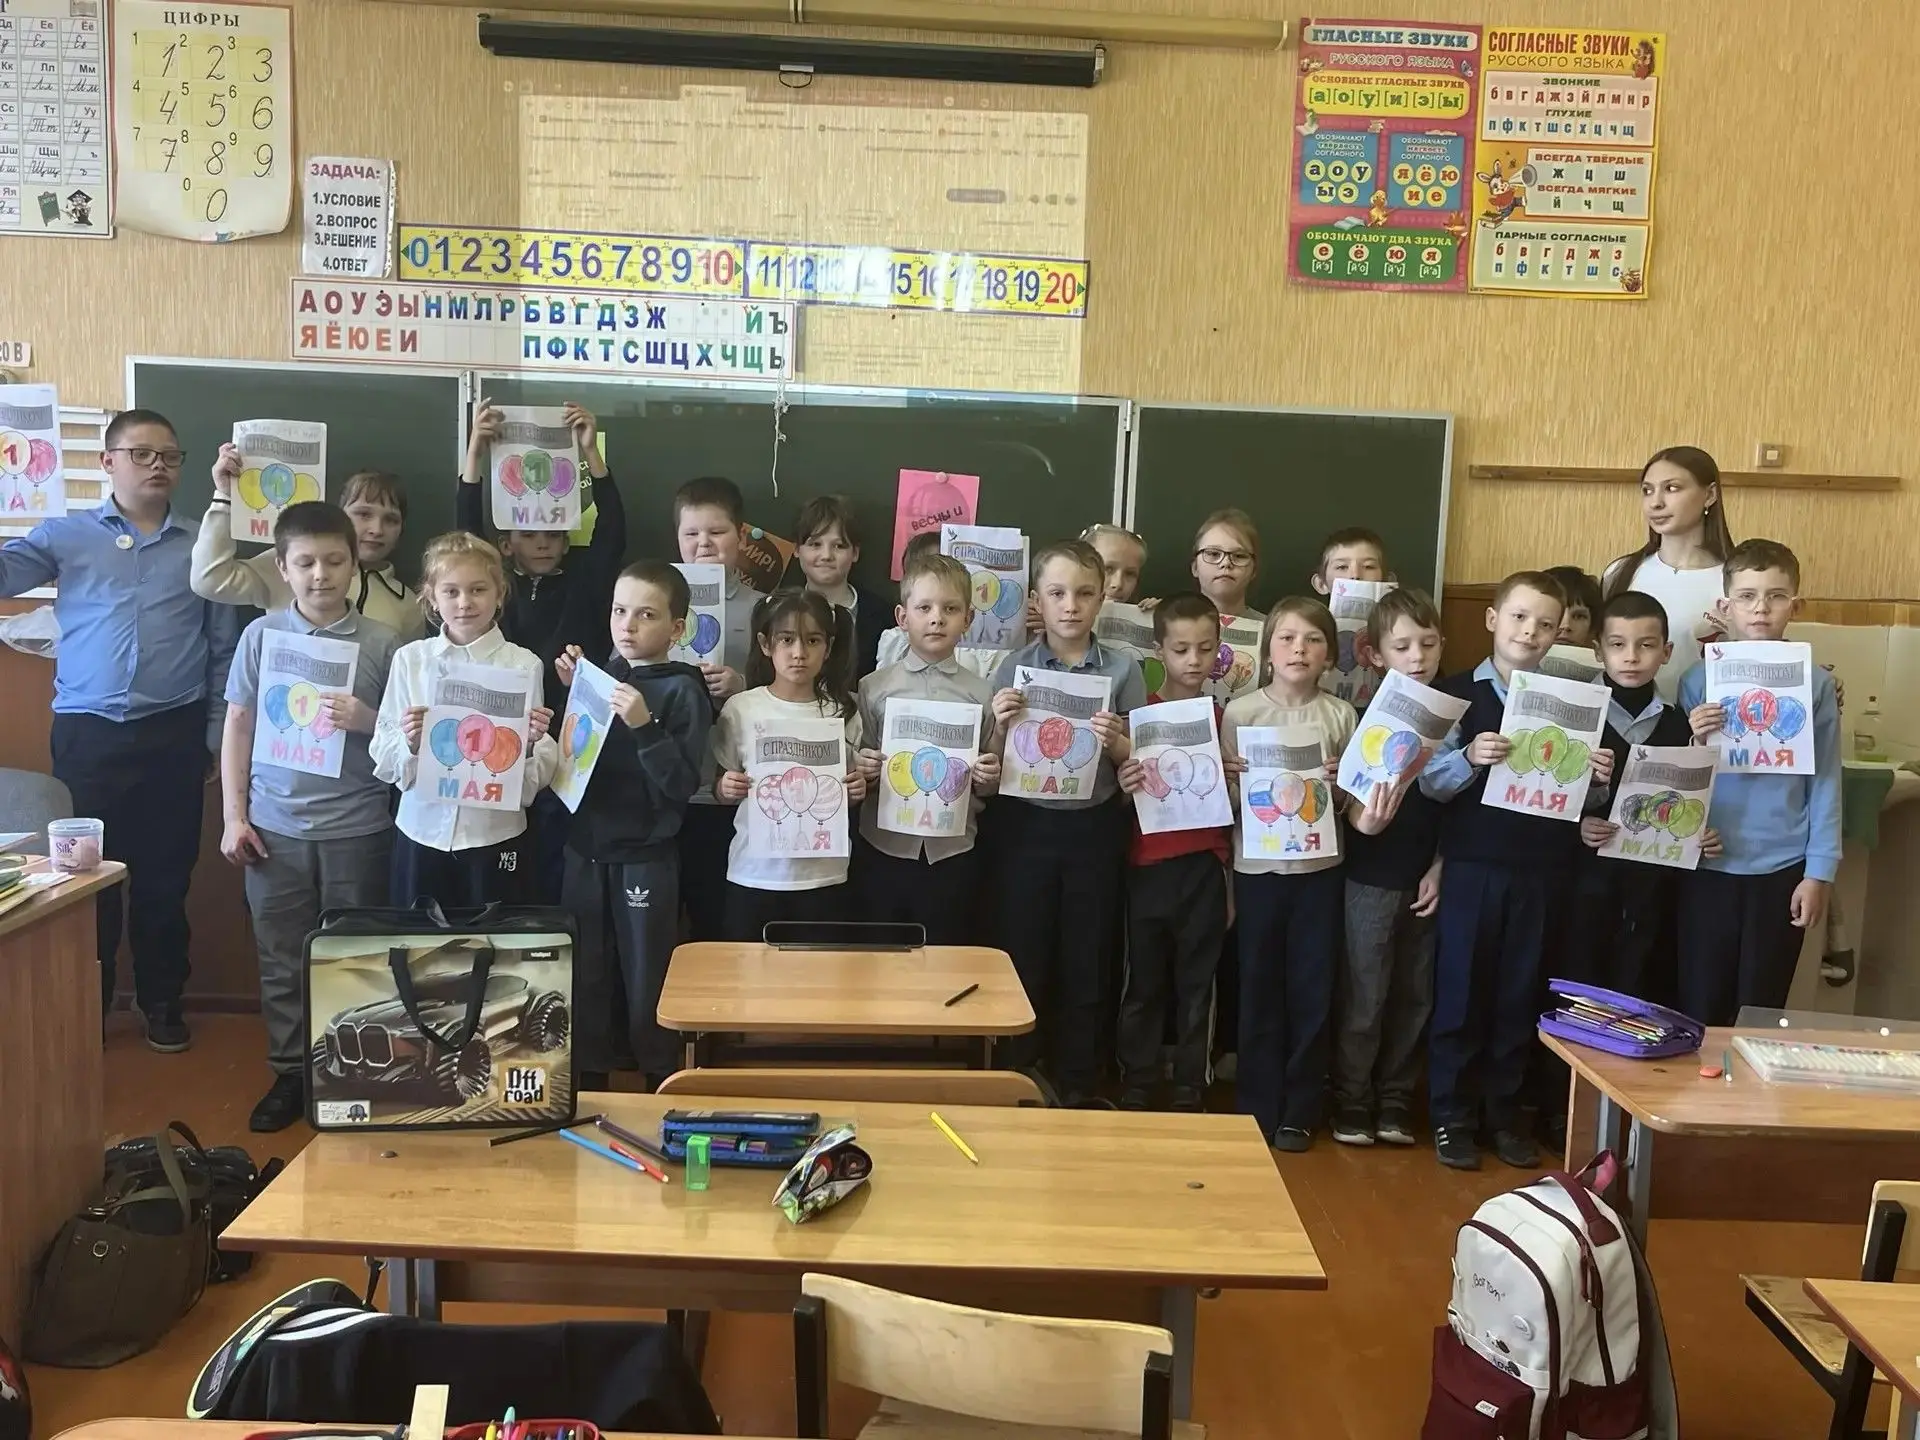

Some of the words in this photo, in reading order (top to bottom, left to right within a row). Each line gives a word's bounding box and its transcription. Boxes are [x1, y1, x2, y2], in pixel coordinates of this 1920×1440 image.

[163, 10, 241, 28] ЦИФРЫ
[1312, 29, 1403, 44] ГЛАСНЫЕ
[1408, 32, 1468, 48] ЗВУКИ
[1488, 31, 1578, 54] СОГЛАСНЫЕ
[1583, 36, 1630, 56] ЗВУКИ
[161, 43, 177, 77] 1
[206, 45, 225, 80] 2
[253, 48, 273, 82] 3
[1329, 52, 1404, 66] РУССКОГО
[1407, 55, 1455, 69] ЯЗЫКА
[1487, 54, 1568, 68] РУССКОГО
[1573, 57, 1625, 69] ЯЗЫКА
[1312, 75, 1373, 85] ОСНОВНЫЕ
[1375, 77, 1426, 87] ГЛАСНЫЕ
[1428, 79, 1465, 88] ЗВУКИ
[1543, 78, 1601, 87] ЗВОНКИЕ
[159, 90, 178, 125] 4
[206, 93, 226, 127] 5
[252, 95, 274, 130] 6
[1545, 109, 1592, 118] ГЛУХИЕ
[159, 138, 178, 172] 7
[206, 141, 226, 175] 8
[253, 143, 274, 177] 9
[1535, 153, 1582, 163] ВСЕГДА
[1587, 155, 1644, 164] ТВЁРДЫЕ
[310, 163, 381, 180] ЗАДАЧА:
[1537, 184, 1584, 194] ВСЕГДА
[1588, 187, 1637, 195] МЯГКИЕ
[206, 188, 227, 222] 0
[312, 192, 381, 209] 1.УСЛОВИЕ
[316, 215, 377, 230] 2.ВОПРОС
[314, 232, 377, 251] 3.РЕШЕНИЕ
[1307, 232, 1385, 243] ОБОЗНАЧАЮТ
[1388, 236, 1412, 245] ДВА
[1414, 237, 1452, 246] ЗВУКА
[1495, 232, 1547, 240] ПАРНЫЕ
[1550, 233, 1627, 243] СОГЛАСНЫЕ
[322, 256, 368, 274] 4.ОТВЕТ
[1044, 271, 1077, 305] 20
[3, 444, 18, 466] 1
[512, 506, 567, 524] МАЯ
[911, 509, 951, 531] весны
[976, 583, 988, 603] 1
[295, 696, 308, 717] 1
[1748, 703, 1764, 723] 1
[465, 729, 481, 752] 1
[1540, 740, 1555, 762] 1
[270, 739, 326, 768] МАЯ
[1729, 748, 1795, 767] МАЯ
[920, 759, 935, 782] 1
[438, 777, 503, 802] МАЯ
[1020, 774, 1080, 795] МАЯ
[1504, 784, 1569, 813] МАЯ
[896, 806, 955, 830] МАЯ
[1620, 838, 1684, 862] МАЯ
[504, 1085, 543, 1103] road
